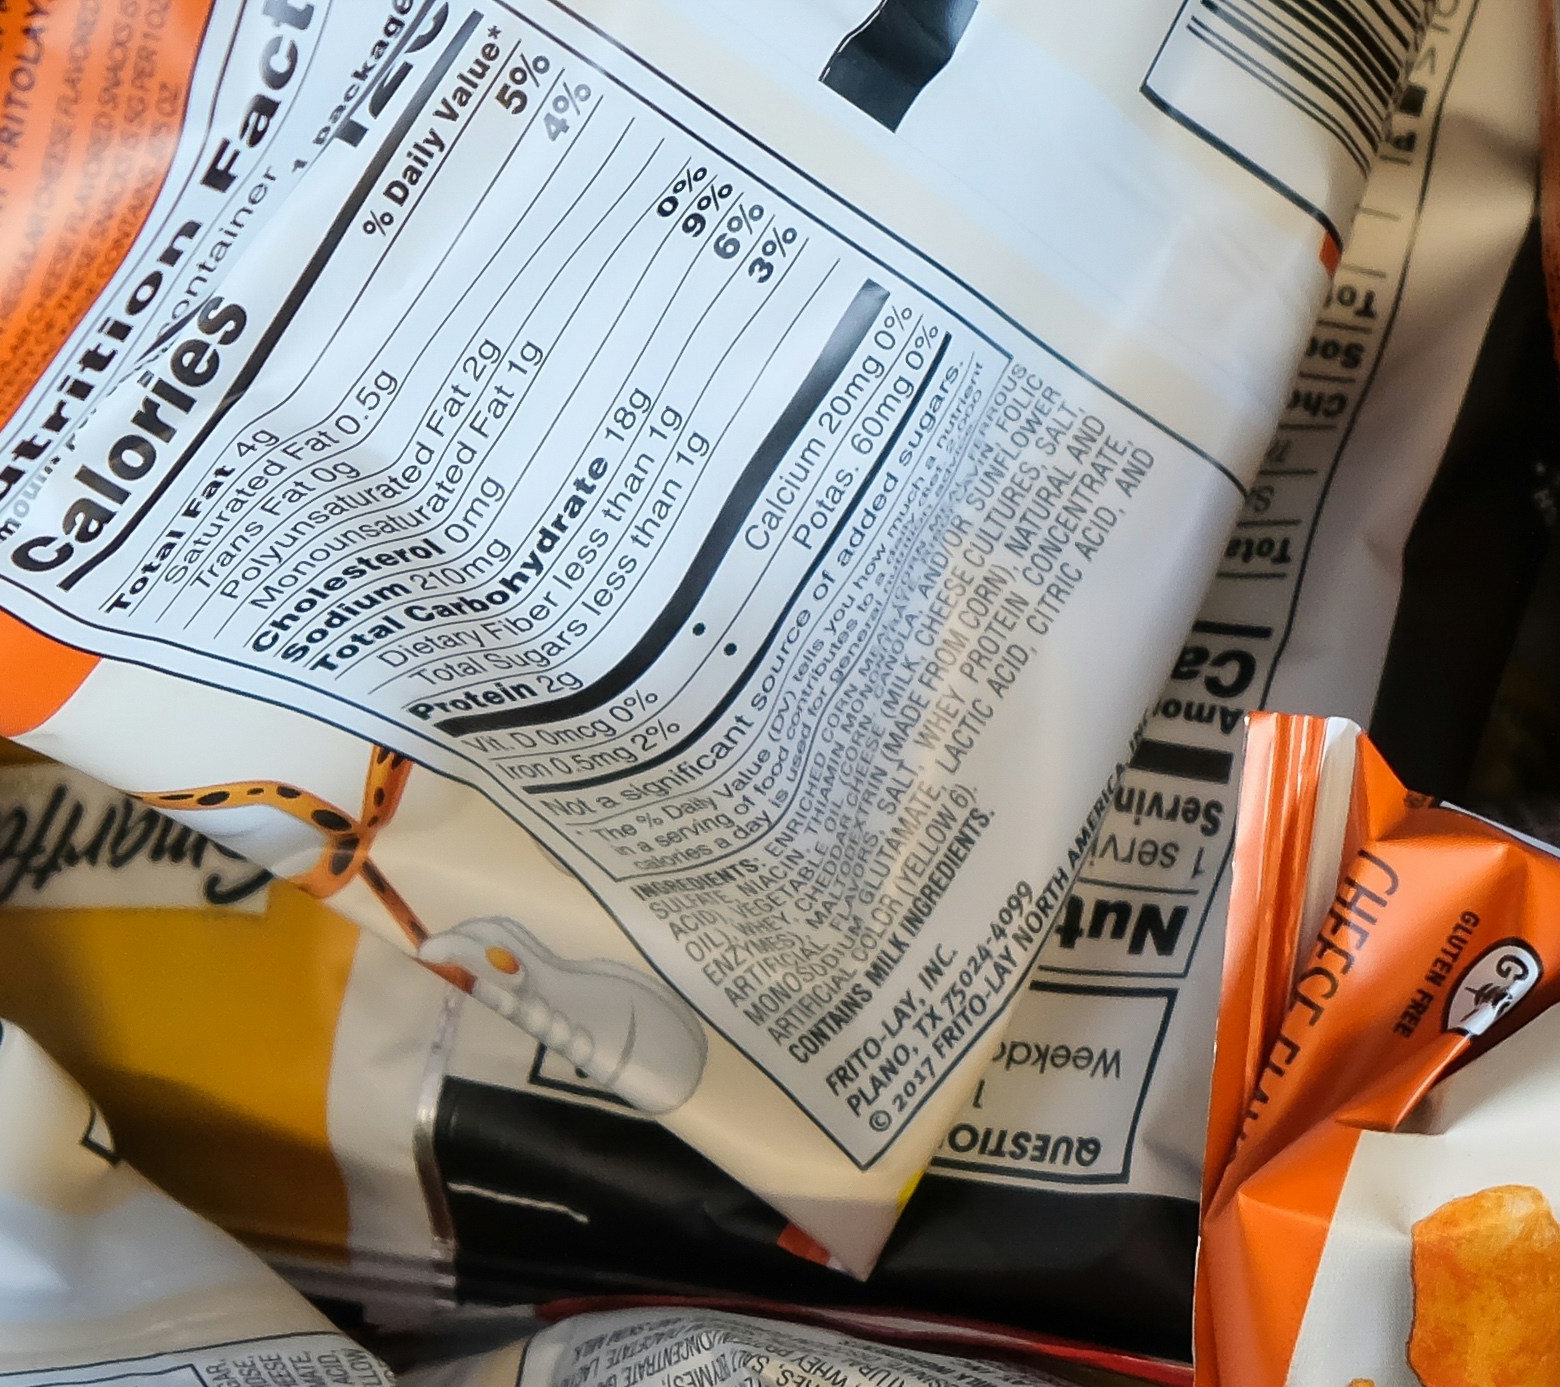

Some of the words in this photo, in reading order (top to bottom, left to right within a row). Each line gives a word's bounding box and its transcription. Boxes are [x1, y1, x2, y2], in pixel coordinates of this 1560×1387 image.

[496, 52, 553, 116] 5%
[384, 120, 447, 208] Daily
[9, 295, 248, 574] Calories
[742, 435, 826, 552] Calcium
[820, 351, 885, 435] 20mg
[873, 304, 913, 351] 0%
[111, 530, 182, 615] Total
[186, 464, 235, 528] Fat
[235, 429, 280, 459] 4g
[252, 539, 447, 656] Cholesterol
[444, 475, 507, 547] 0mg
[311, 611, 404, 672] Total
[411, 457, 611, 624] Carbohydrate
[603, 387, 654, 444] 18g
[283, 581, 411, 663] Sodium
[411, 536, 512, 596] 210mg
[1393, 987, 1433, 1038] FREE
[1424, 910, 1480, 988] GLUTEN
